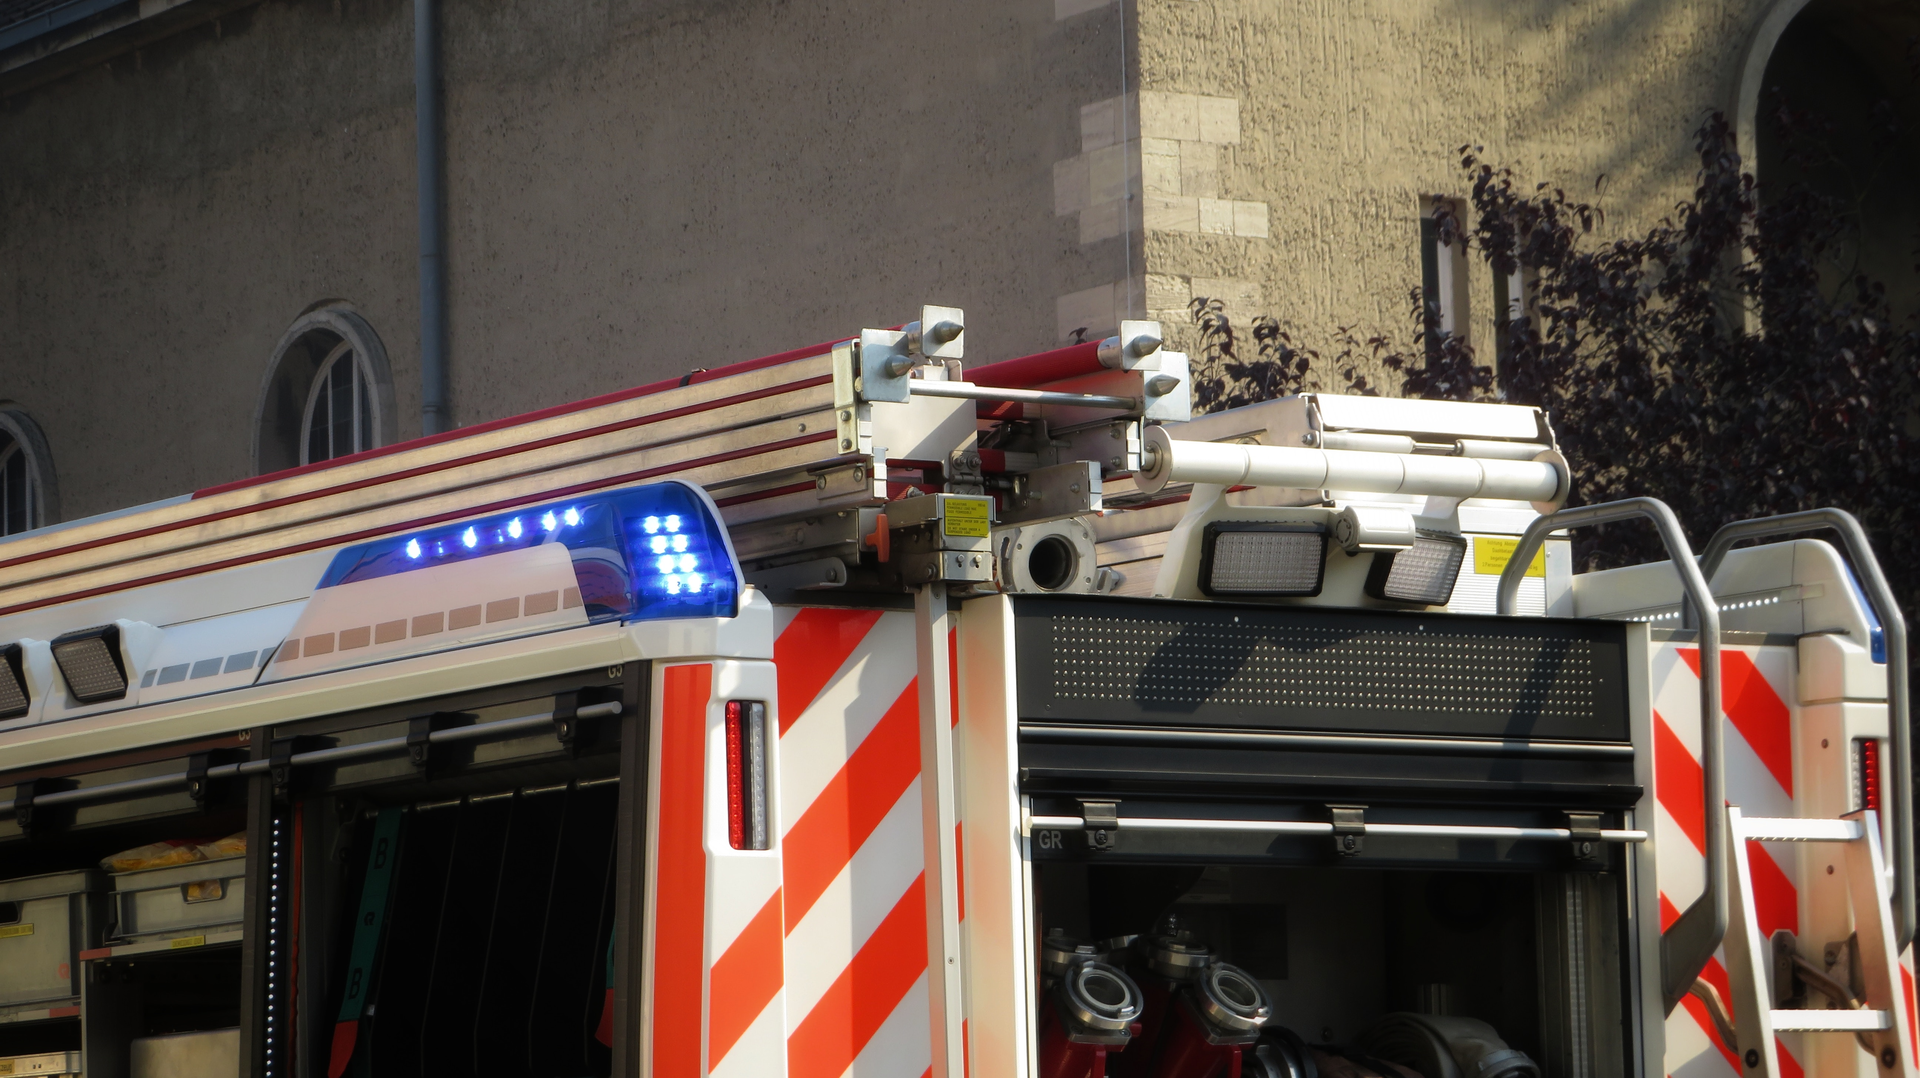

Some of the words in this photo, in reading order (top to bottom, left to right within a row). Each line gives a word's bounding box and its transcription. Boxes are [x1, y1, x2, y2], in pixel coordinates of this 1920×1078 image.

[373, 836, 389, 870] B
[1038, 830, 1063, 849] GR
[348, 967, 363, 1000] B
